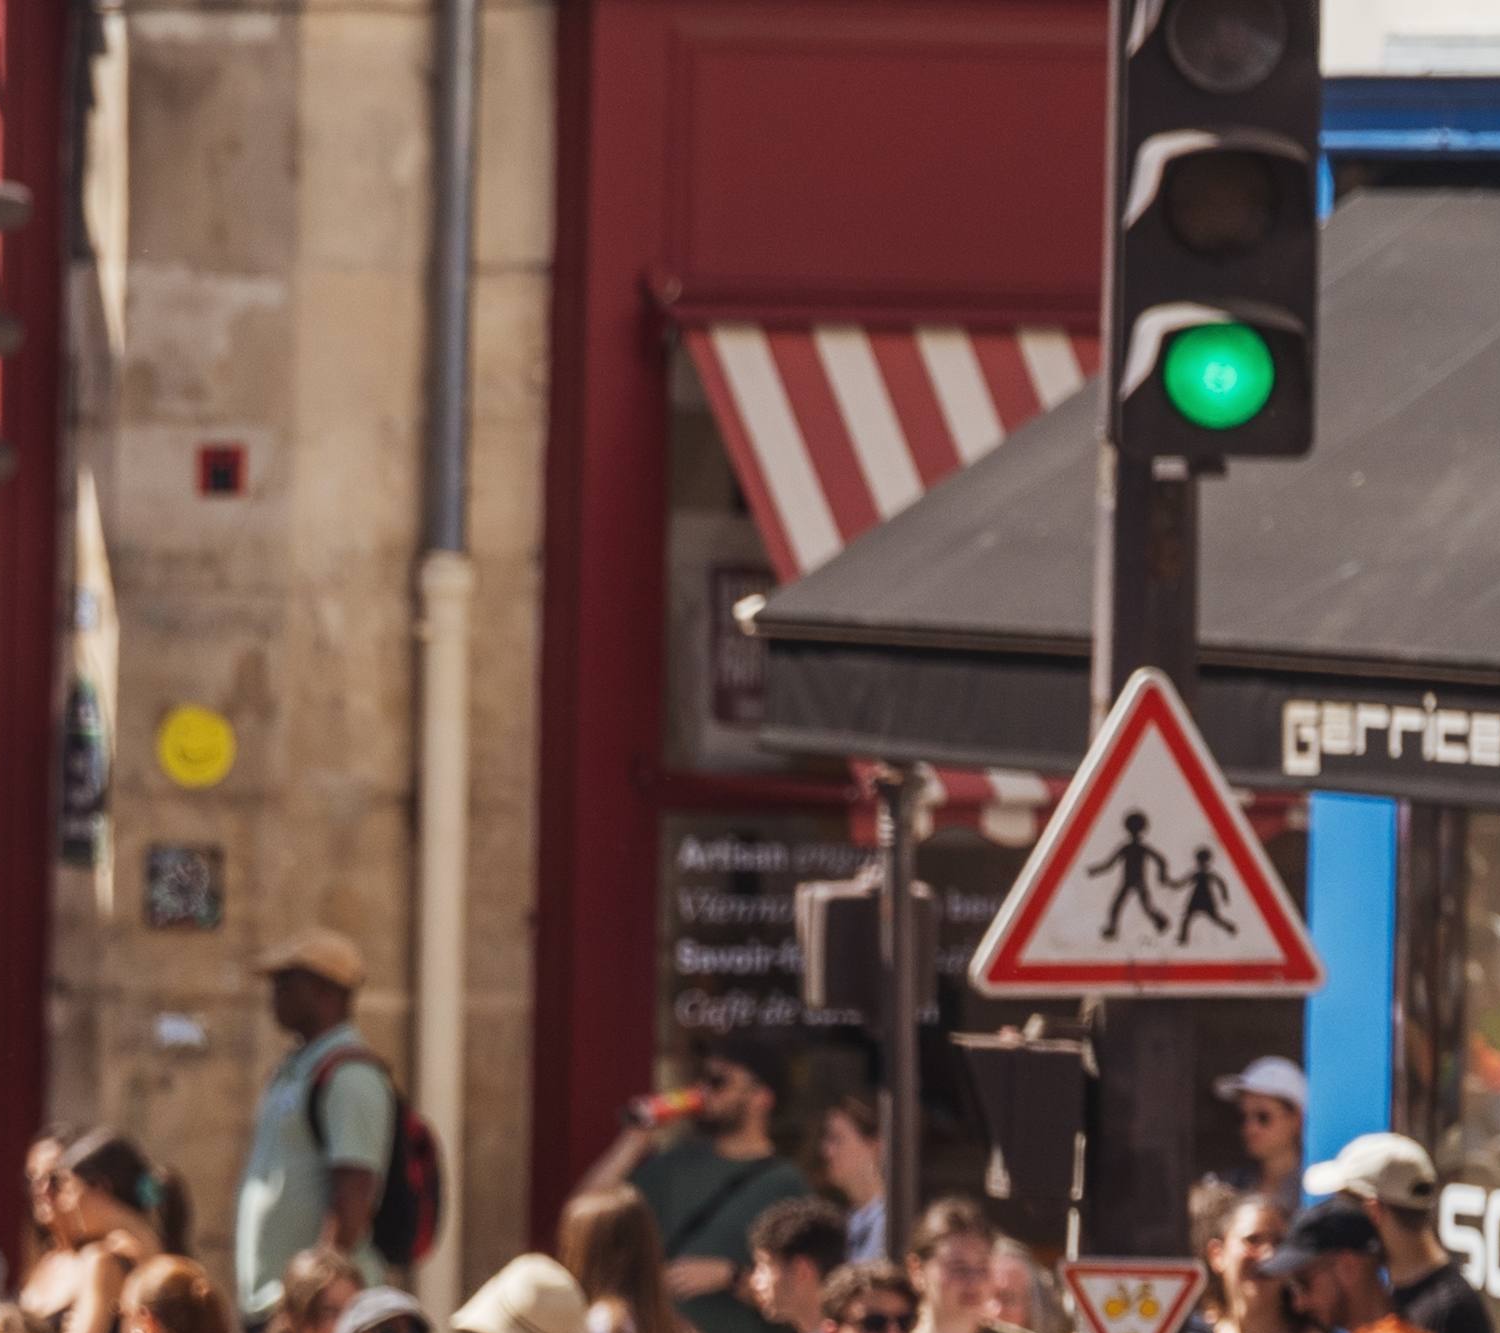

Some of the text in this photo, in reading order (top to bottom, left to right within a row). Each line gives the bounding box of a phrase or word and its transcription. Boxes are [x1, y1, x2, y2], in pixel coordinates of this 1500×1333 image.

[678, 834, 790, 872] Artisan
[676, 991, 755, 1032] Café
[759, 993, 796, 1025] de
